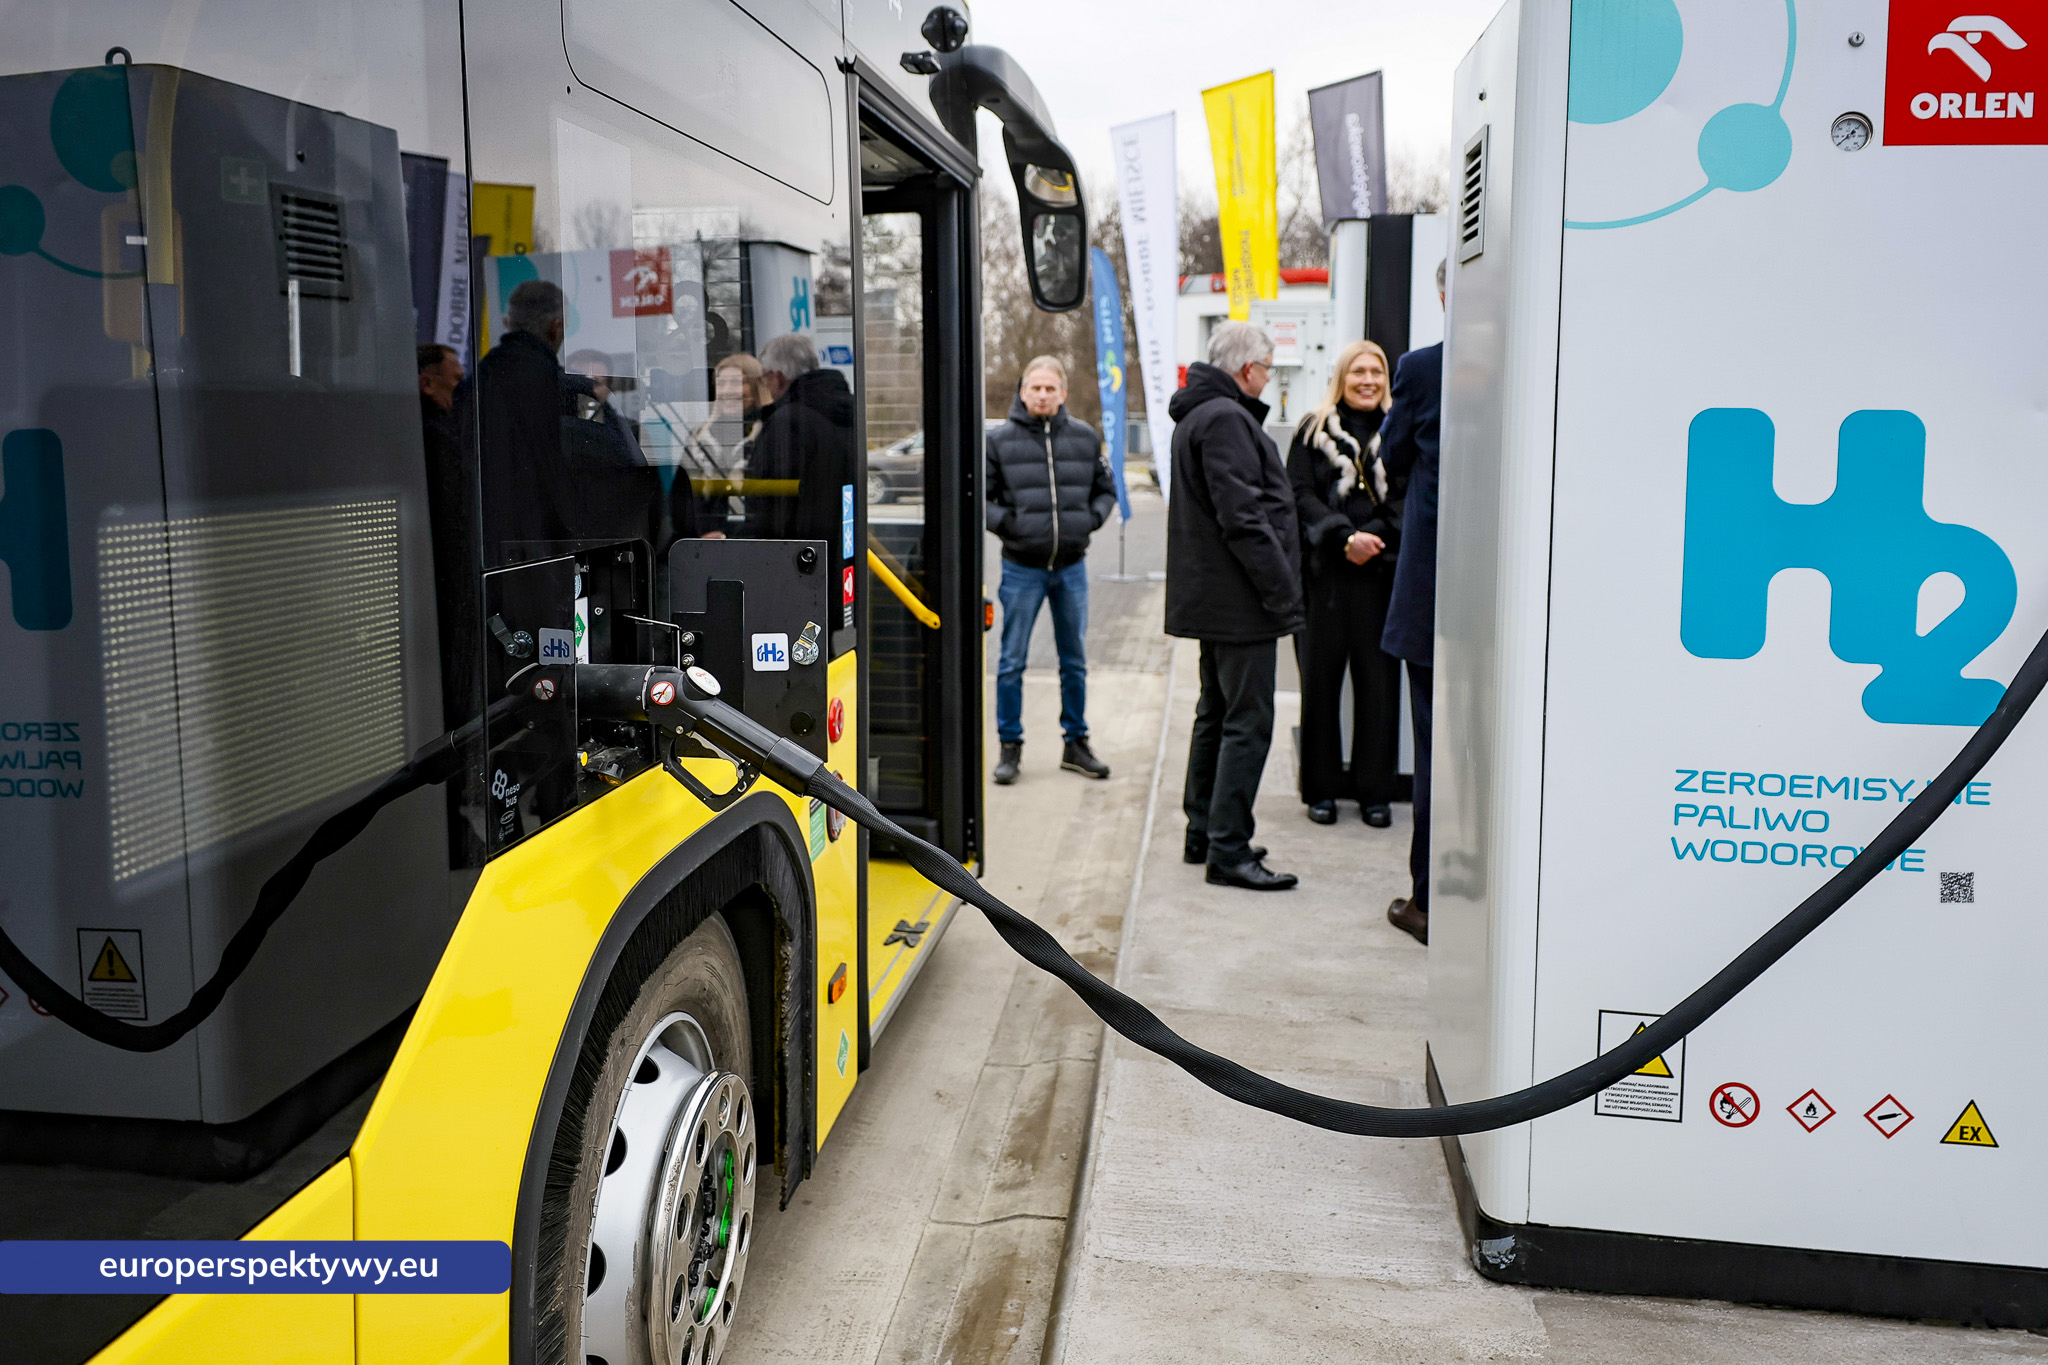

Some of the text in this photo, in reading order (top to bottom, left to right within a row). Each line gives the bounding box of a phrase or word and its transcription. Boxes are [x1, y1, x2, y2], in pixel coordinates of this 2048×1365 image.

[1909, 92, 2034, 119] ORLEN
[1681, 407, 2017, 725] H2
[505, 783, 520, 796] neso
[505, 795, 517, 808] bus
[1674, 769, 1992, 806] ZEROEMISYE
[1674, 803, 1830, 833] PALIWO
[1671, 836, 1926, 872] WODOROE
[1959, 1126, 1982, 1141] EX
